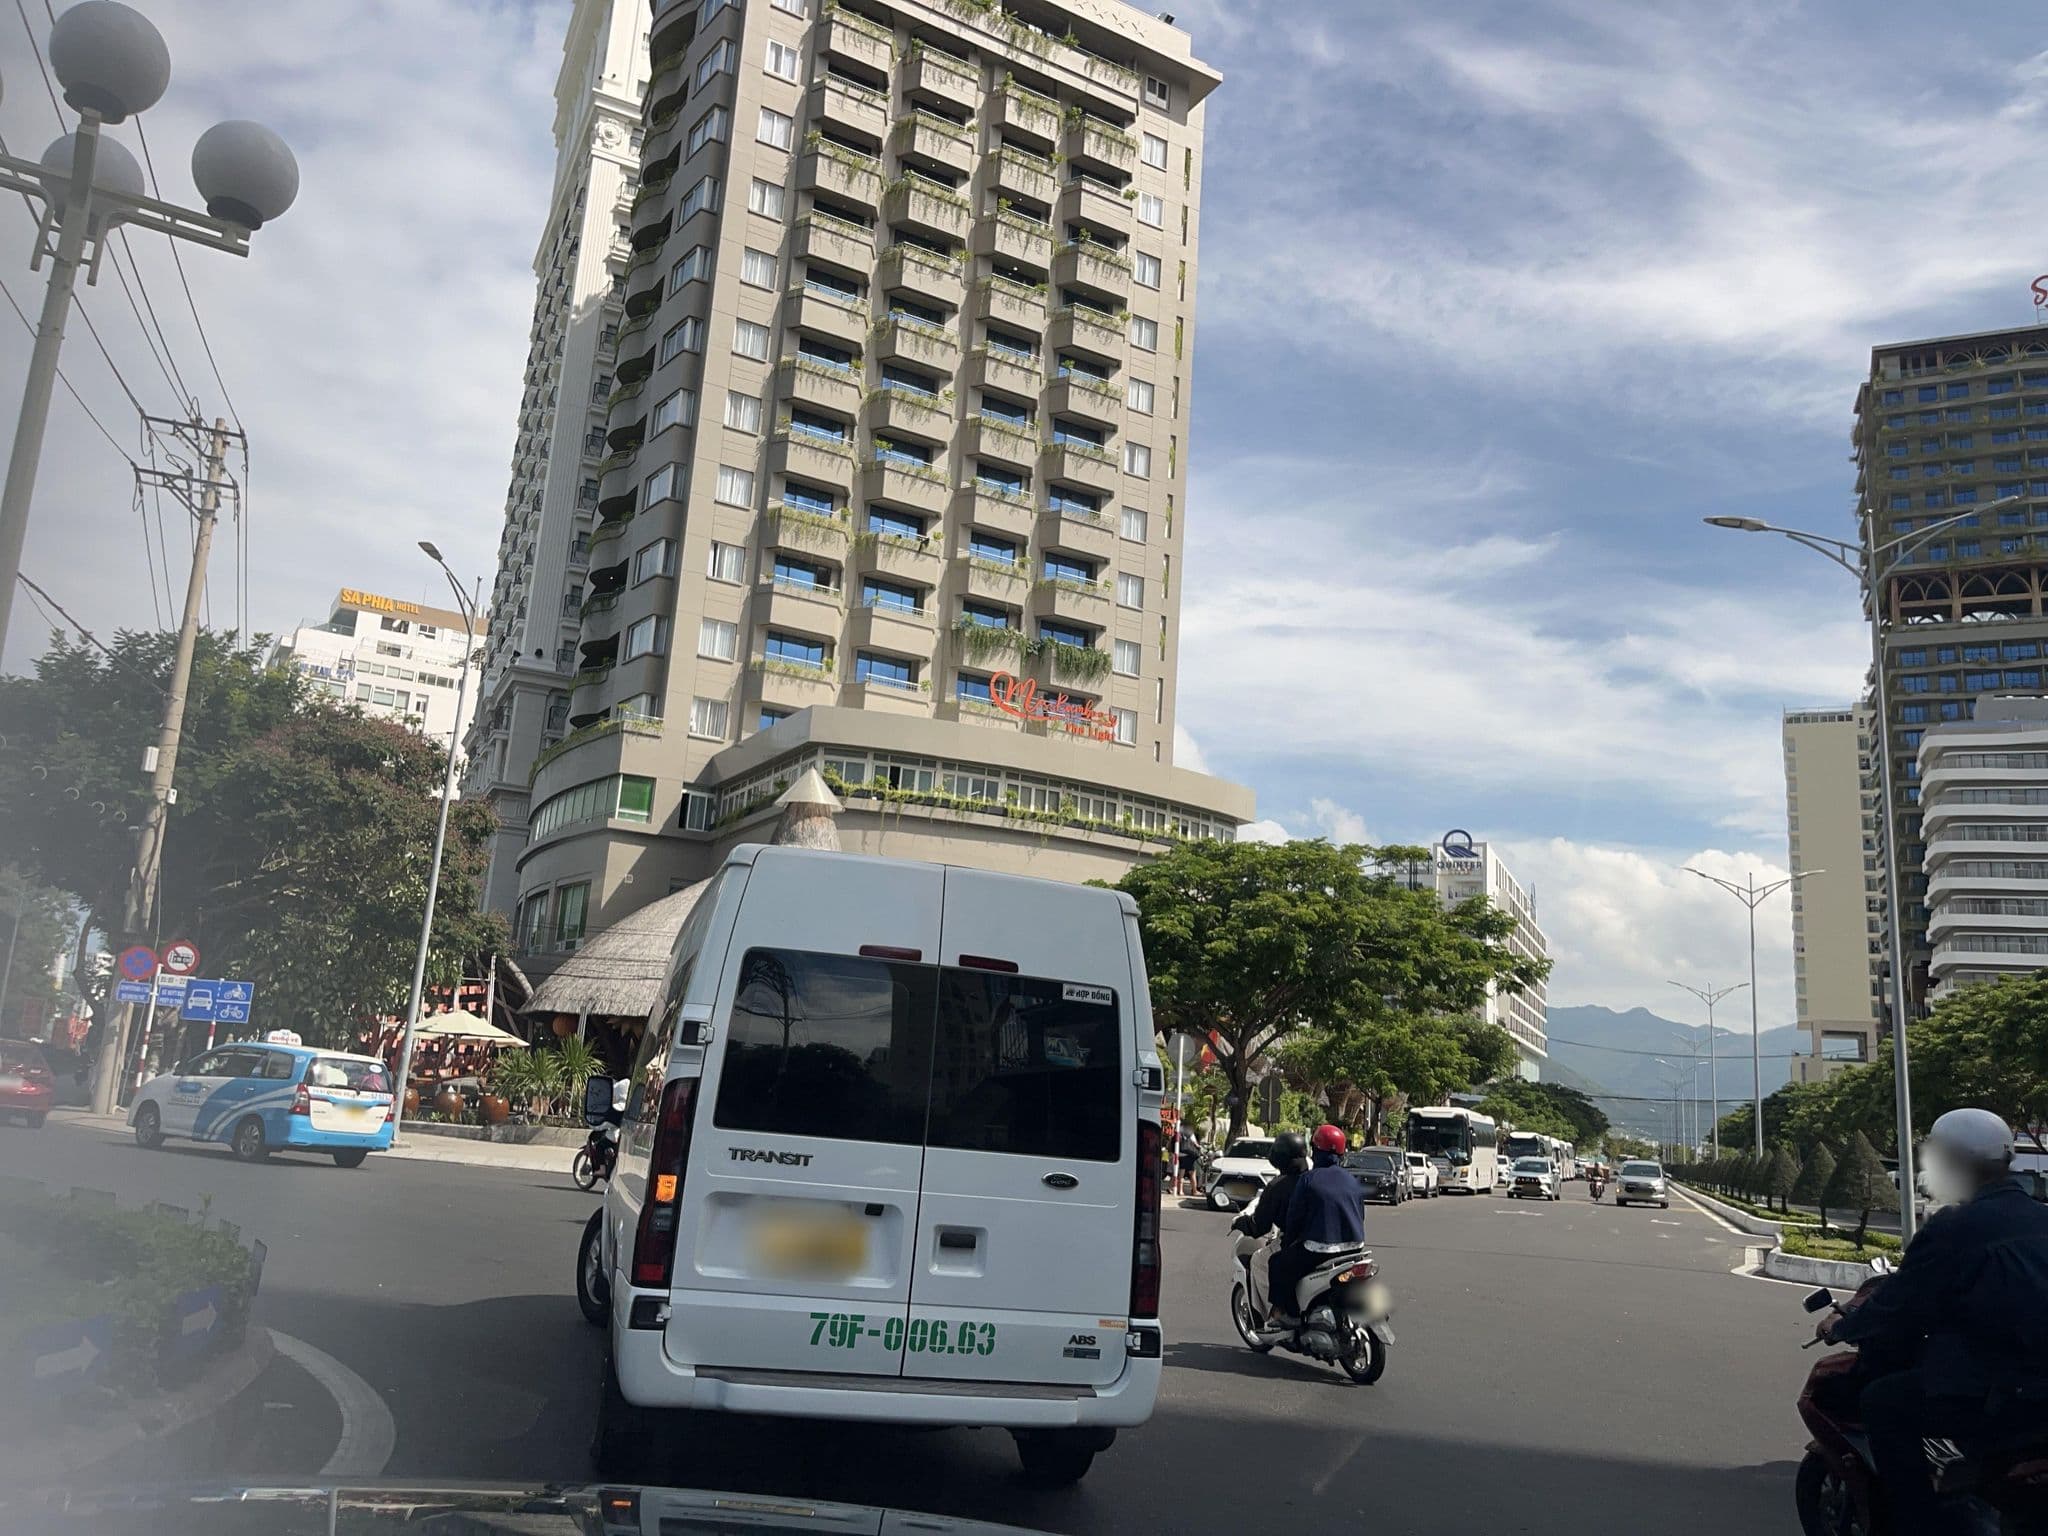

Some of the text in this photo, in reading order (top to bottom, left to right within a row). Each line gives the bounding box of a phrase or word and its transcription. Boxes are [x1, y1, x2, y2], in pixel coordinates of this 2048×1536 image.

[396, 602, 419, 615] HOTEL
[728, 1147, 814, 1167] TRANSIT
[810, 1312, 996, 1356] 79F-006.63
[1069, 1334, 1097, 1346] ABS
